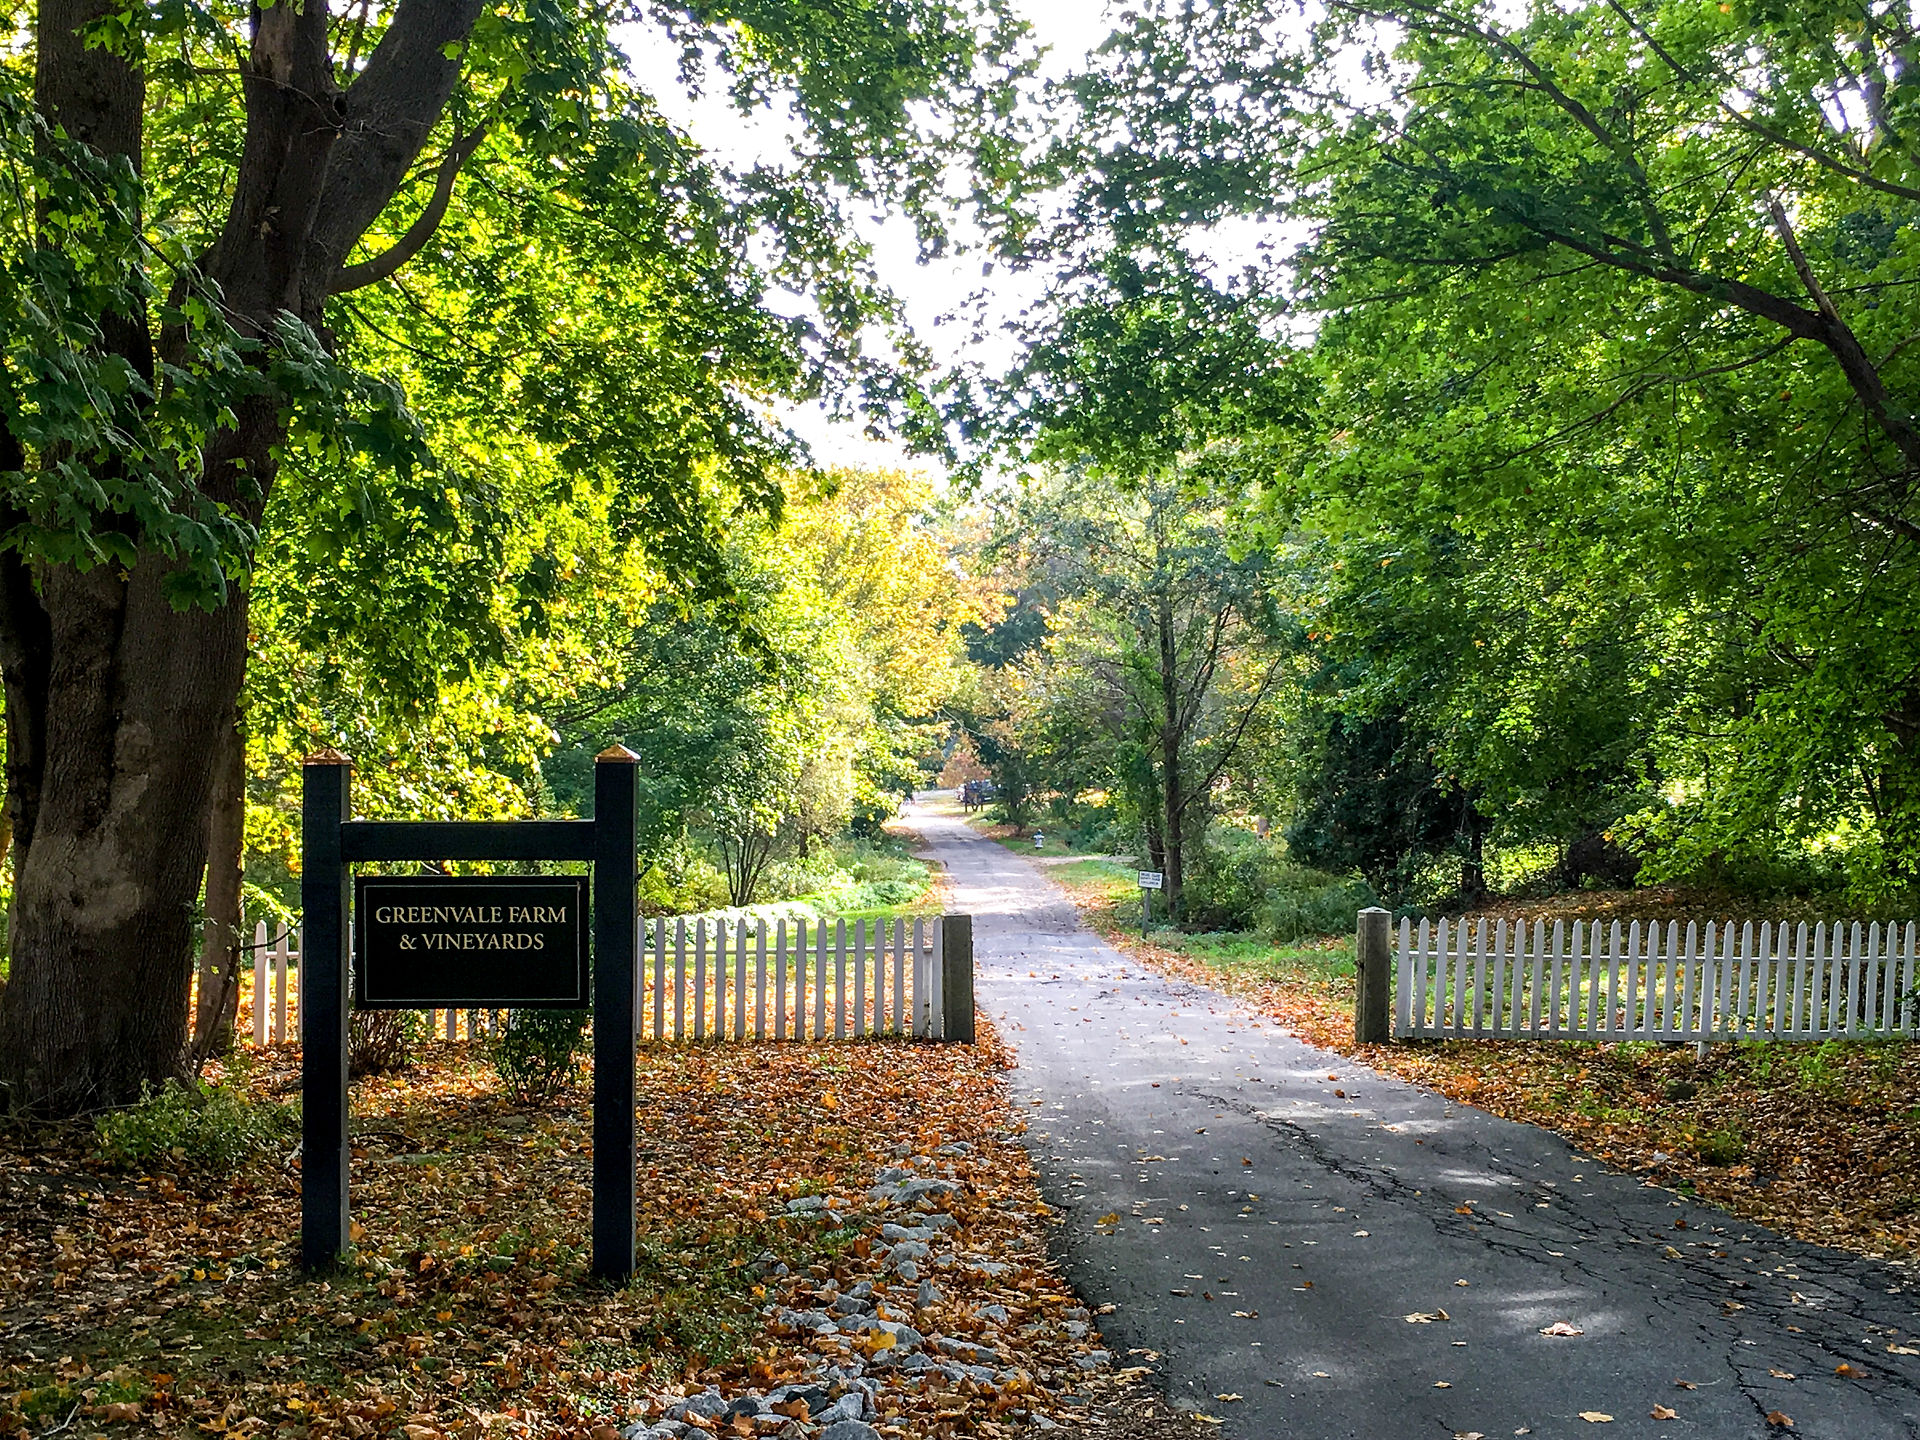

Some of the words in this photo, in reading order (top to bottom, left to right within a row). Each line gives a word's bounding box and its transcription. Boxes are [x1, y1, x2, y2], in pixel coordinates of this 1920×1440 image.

[375, 906, 504, 924] GREENVALE
[508, 906, 567, 924] FARM
[399, 933, 417, 950] &
[421, 933, 545, 950] VINEYARDS
